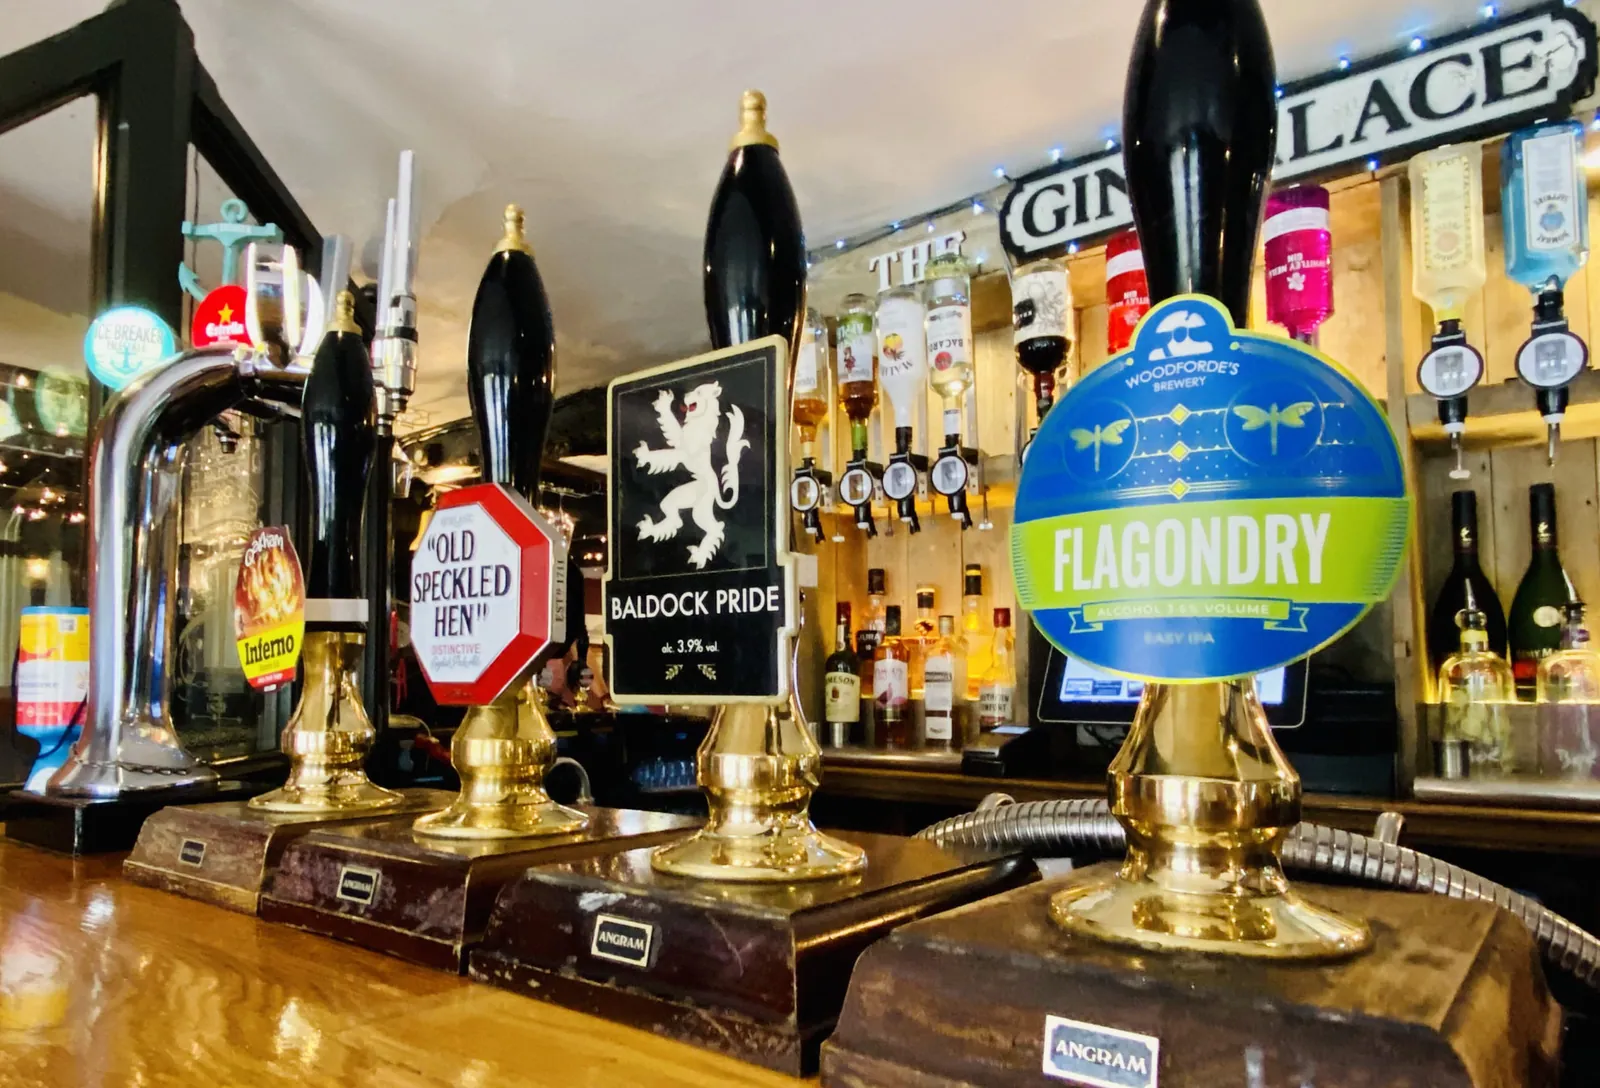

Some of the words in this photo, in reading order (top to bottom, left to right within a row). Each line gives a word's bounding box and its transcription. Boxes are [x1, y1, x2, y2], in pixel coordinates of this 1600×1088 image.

[1275, 30, 1550, 165] LACE
[928, 337, 964, 353] BACARD
[1125, 360, 1240, 389] WOODFORDE'S
[1152, 376, 1207, 392] BREWERY
[1054, 513, 1331, 592] FLAGONDRY
[413, 564, 511, 602] SPECKLED
[611, 591, 709, 619] BALDOCK
[716, 586, 779, 614] PRIDE
[1097, 603, 1161, 617] ALCOHOL
[1204, 603, 1269, 615] VOLUME
[245, 635, 294, 665] Inferno
[677, 639, 704, 654] 3.9%
[826, 675, 855, 687] MESON
[598, 931, 645, 951] ANGRAM
[1055, 1039, 1148, 1075] ANGRAM
